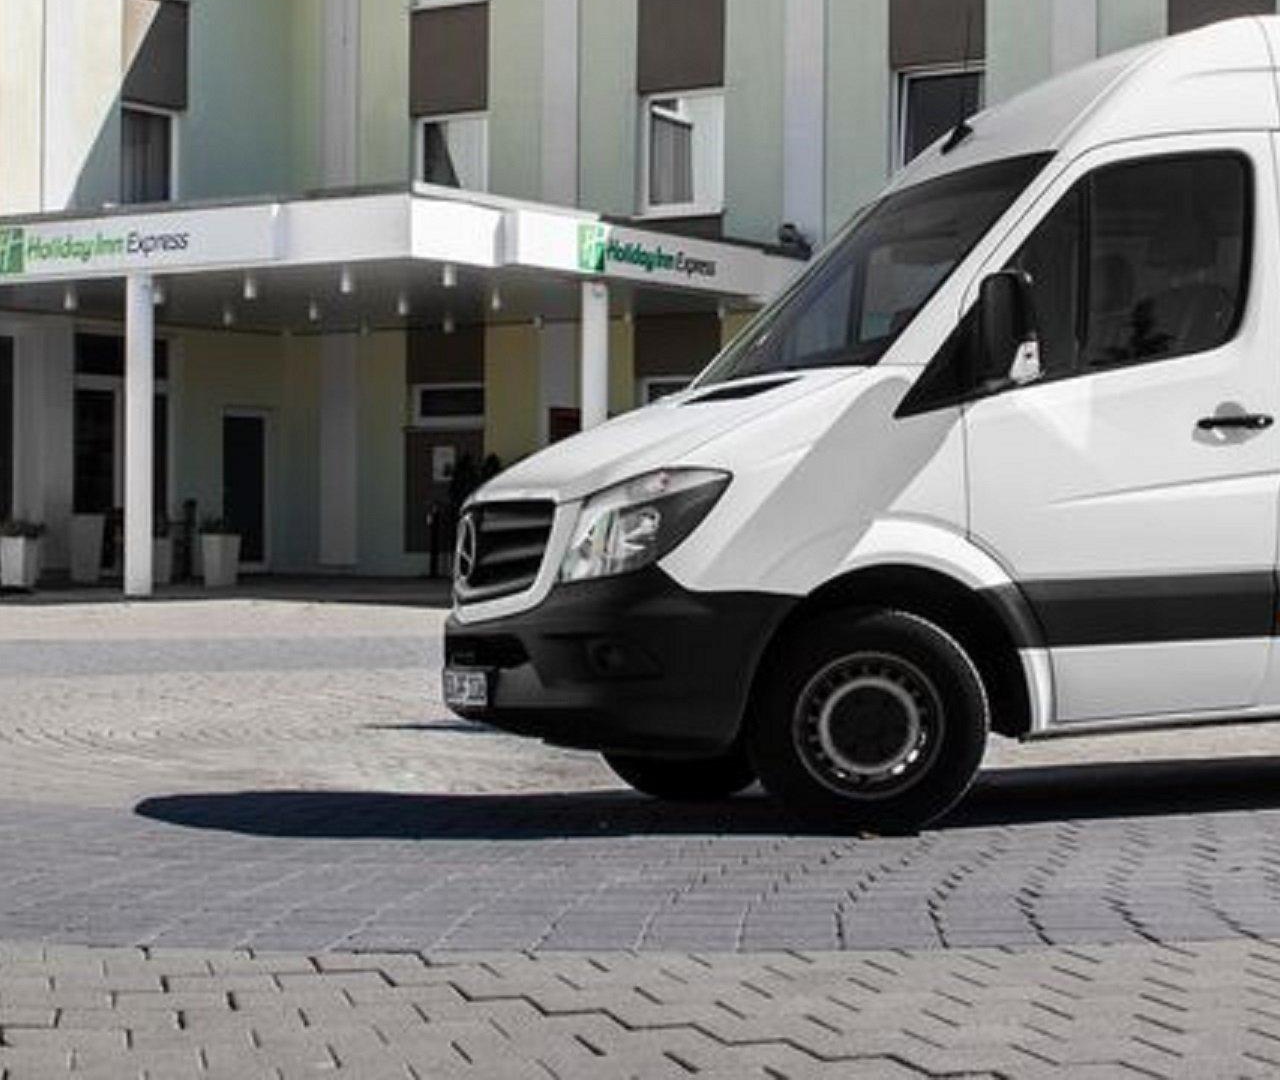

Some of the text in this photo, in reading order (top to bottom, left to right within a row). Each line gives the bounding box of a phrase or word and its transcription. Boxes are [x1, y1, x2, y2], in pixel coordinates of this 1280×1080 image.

[28, 230, 189, 261] Holiday Inn Express
[607, 238, 655, 272] Holiday
[676, 252, 716, 279] Express
